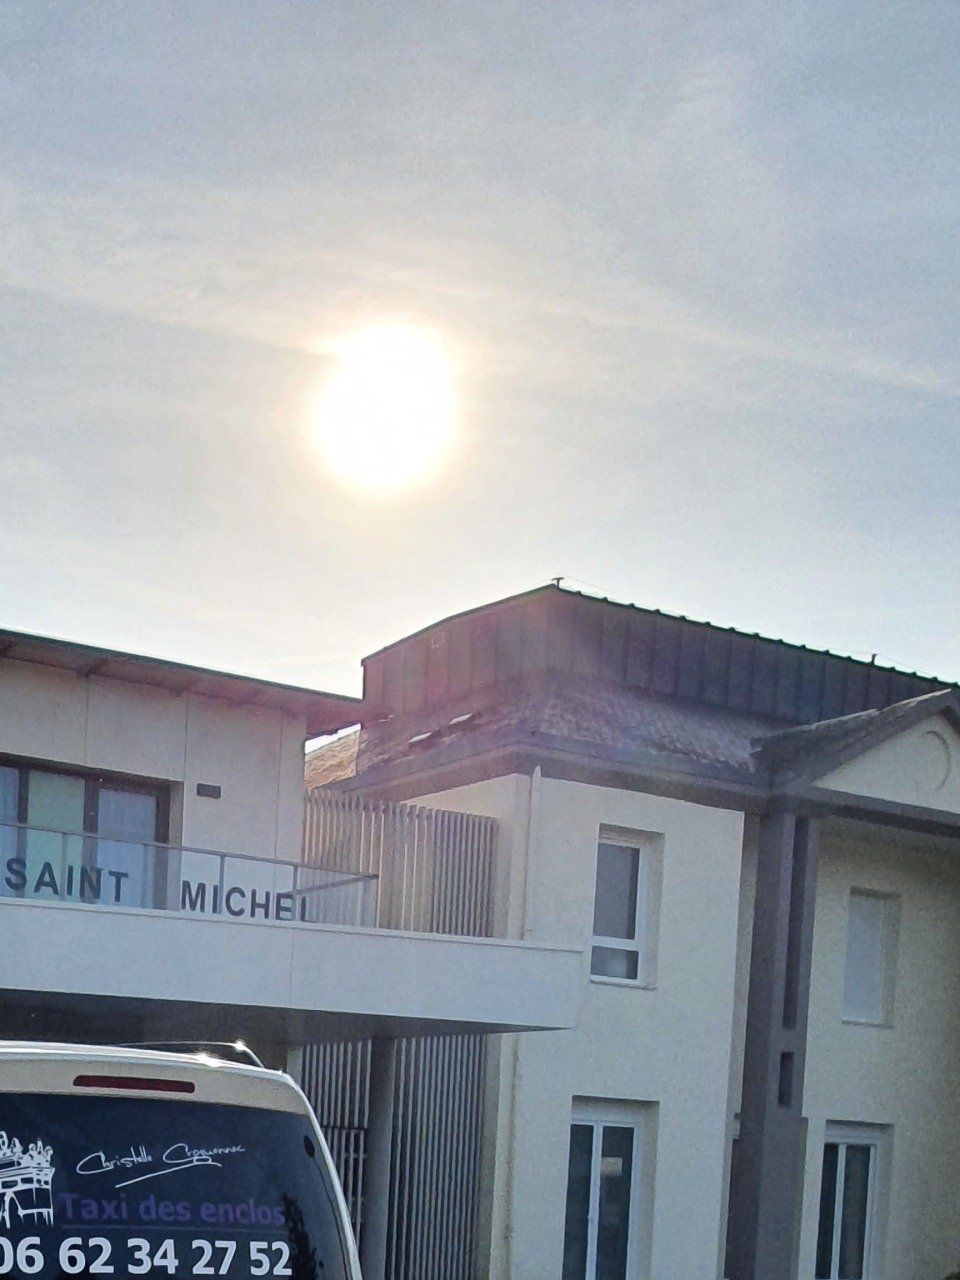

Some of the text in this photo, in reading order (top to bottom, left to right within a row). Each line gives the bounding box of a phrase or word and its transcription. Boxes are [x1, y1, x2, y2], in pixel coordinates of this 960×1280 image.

[5, 858, 129, 902] SAINT
[59, 1192, 286, 1226] Taxi des enclos
[58, 1236, 115, 1275] 62
[127, 1238, 179, 1275] 34
[191, 1239, 237, 1275] 27
[249, 1240, 293, 1277] 52
